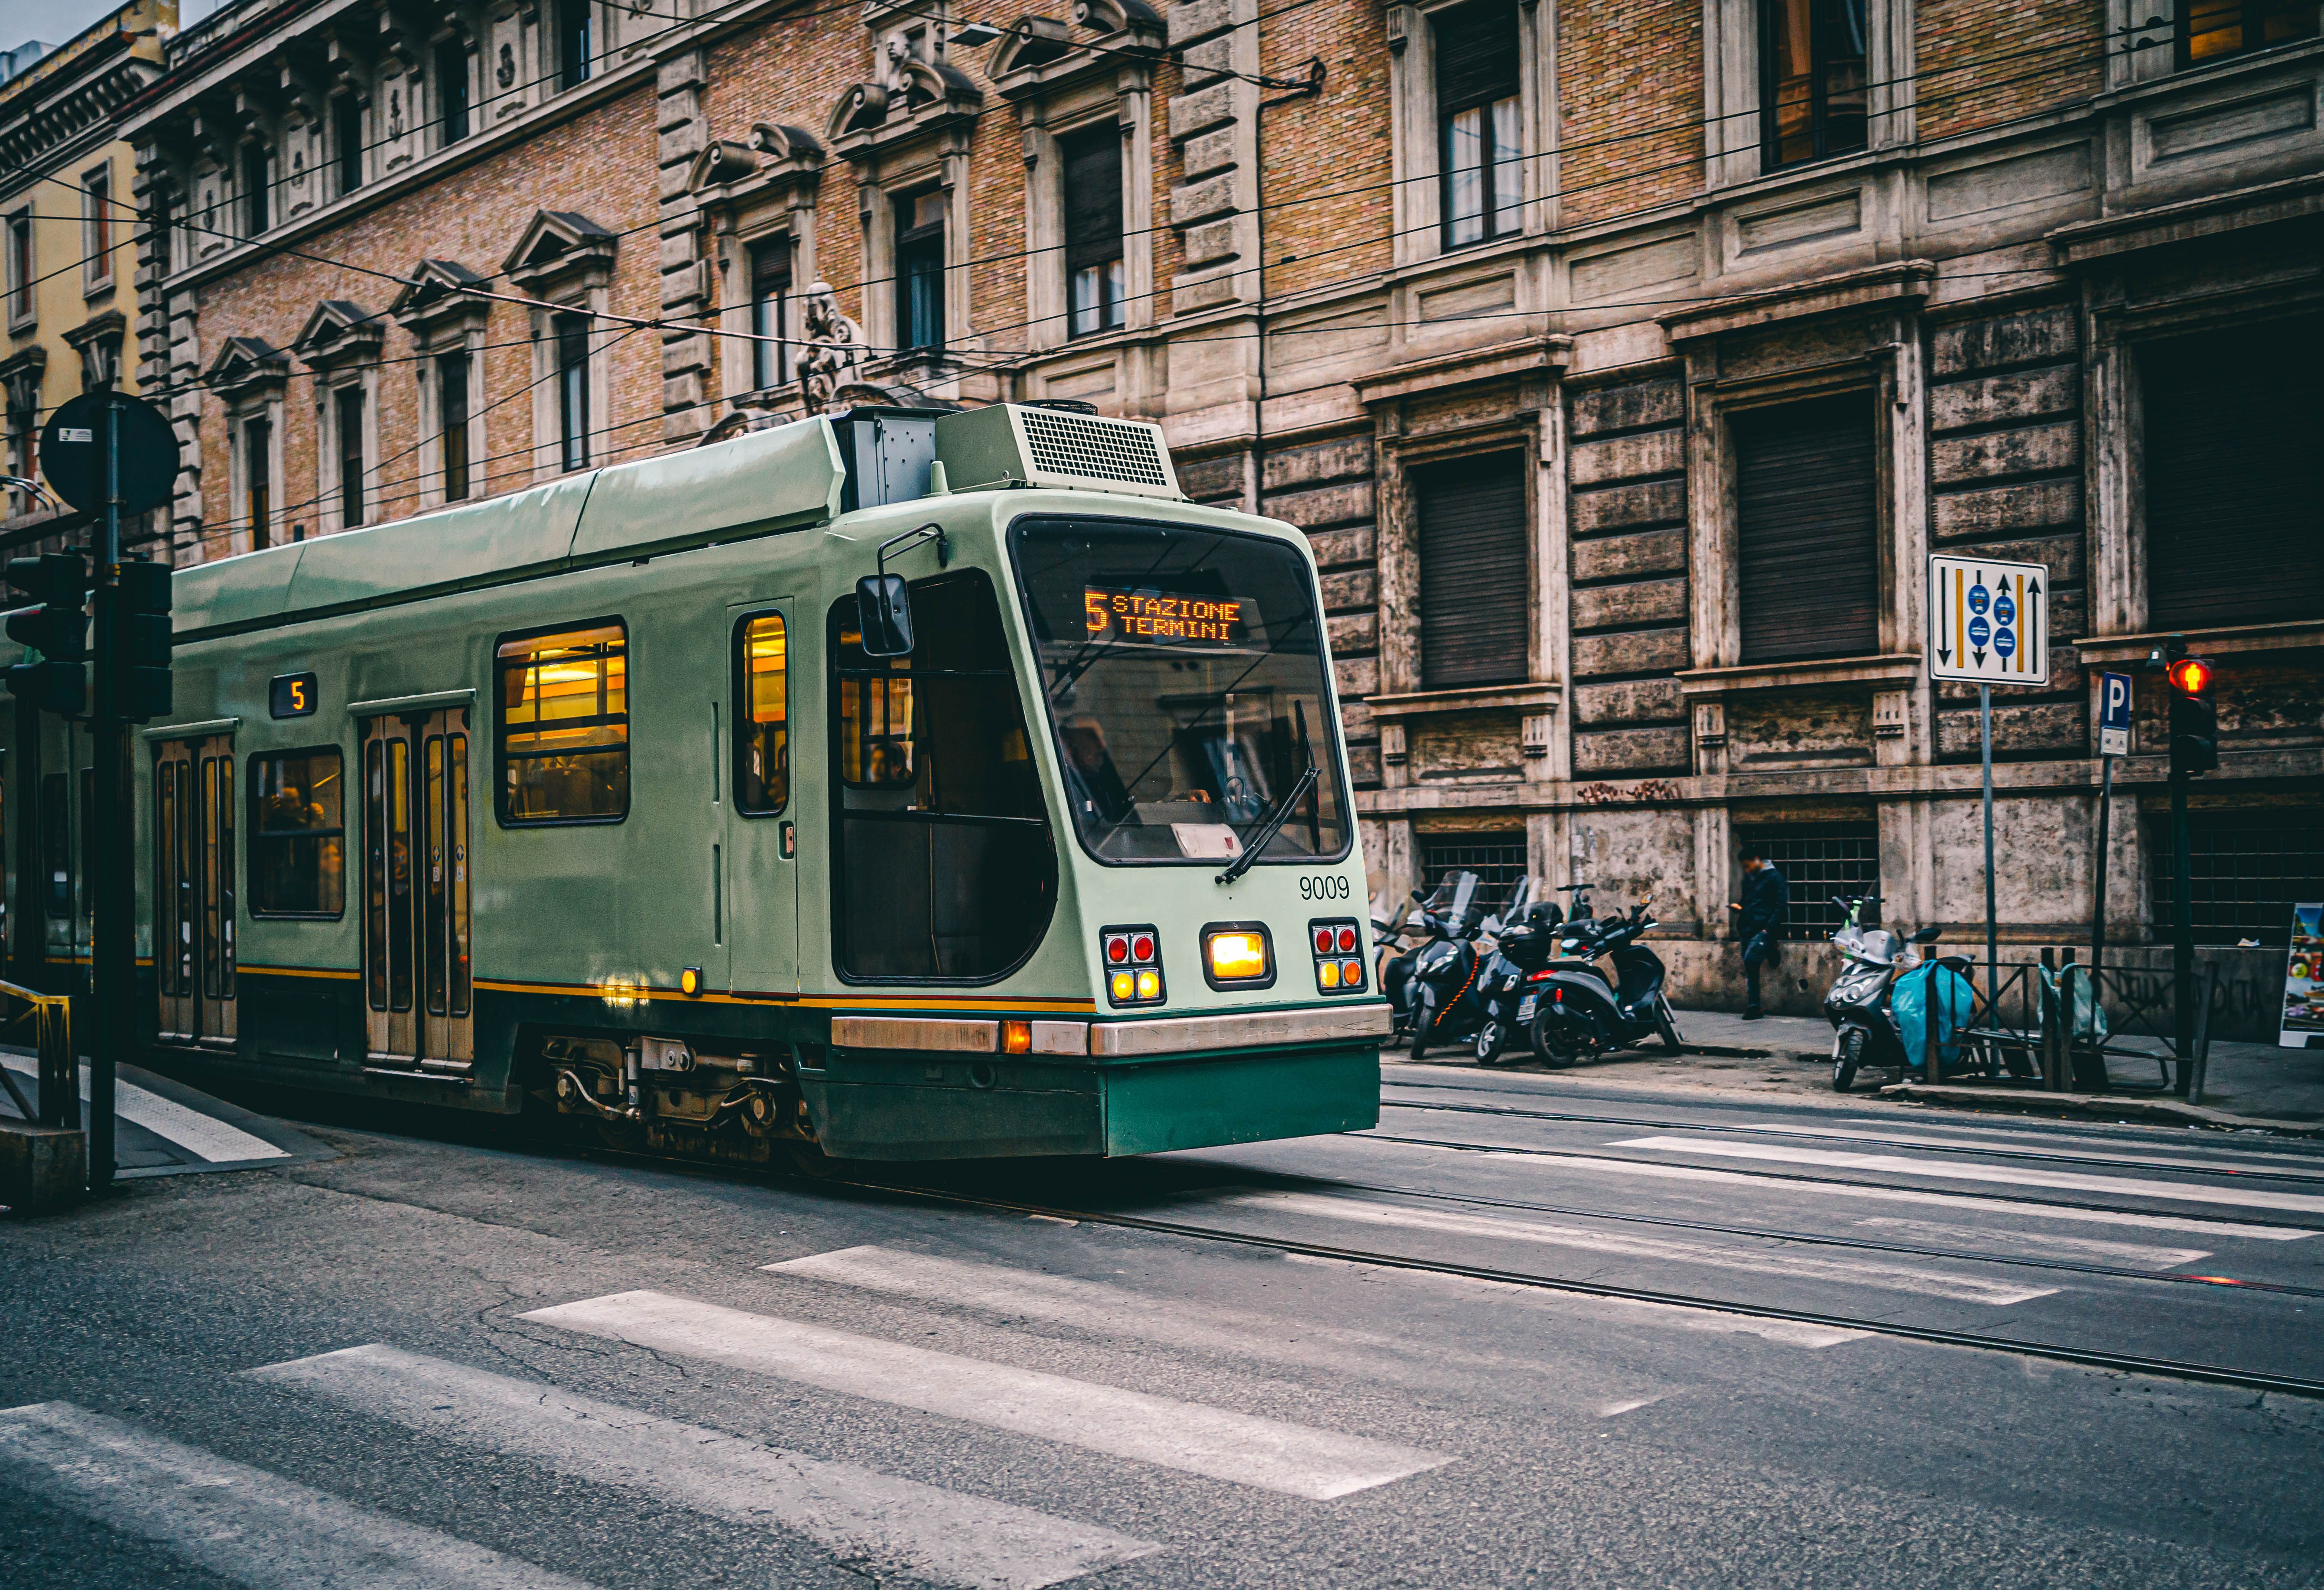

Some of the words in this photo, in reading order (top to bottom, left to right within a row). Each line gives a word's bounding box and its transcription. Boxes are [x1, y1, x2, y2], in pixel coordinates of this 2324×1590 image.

[1085, 592, 1108, 631] 5
[1112, 595, 1240, 621] STAZIONE
[1121, 616, 1229, 640] TERMINI
[291, 681, 304, 710] 5
[2108, 679, 2125, 721] P
[1300, 876, 1349, 900] 9009
